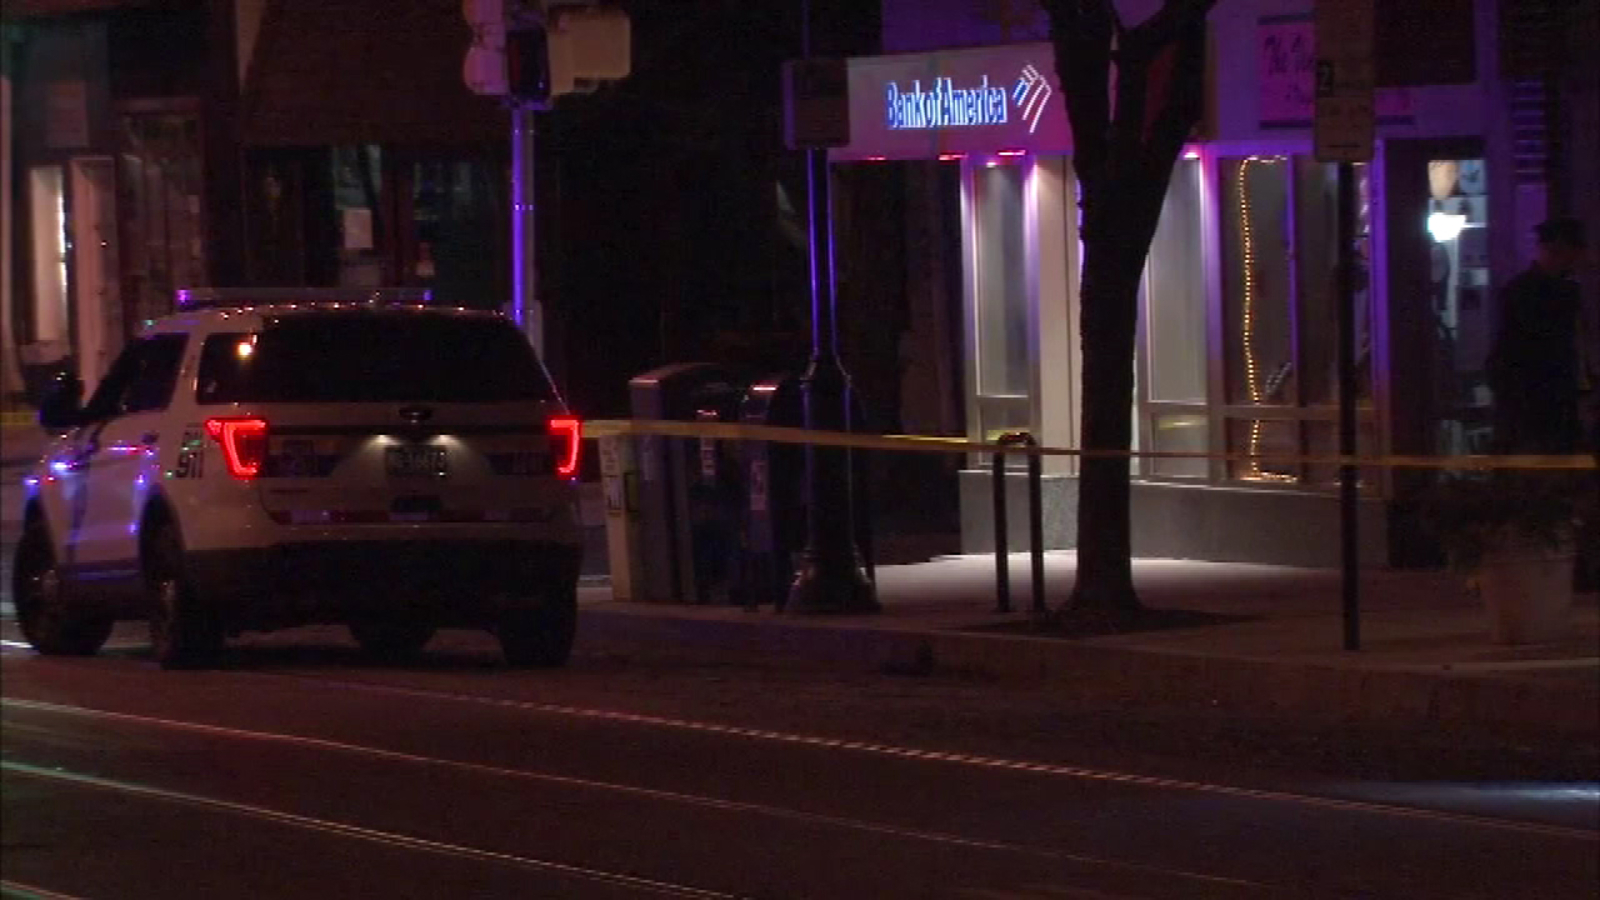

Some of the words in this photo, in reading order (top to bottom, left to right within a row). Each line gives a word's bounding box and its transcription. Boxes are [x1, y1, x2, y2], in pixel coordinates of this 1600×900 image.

[886, 80, 926, 129] Bank
[925, 77, 942, 128] of
[941, 74, 1008, 127] America
[175, 450, 205, 479] 911
